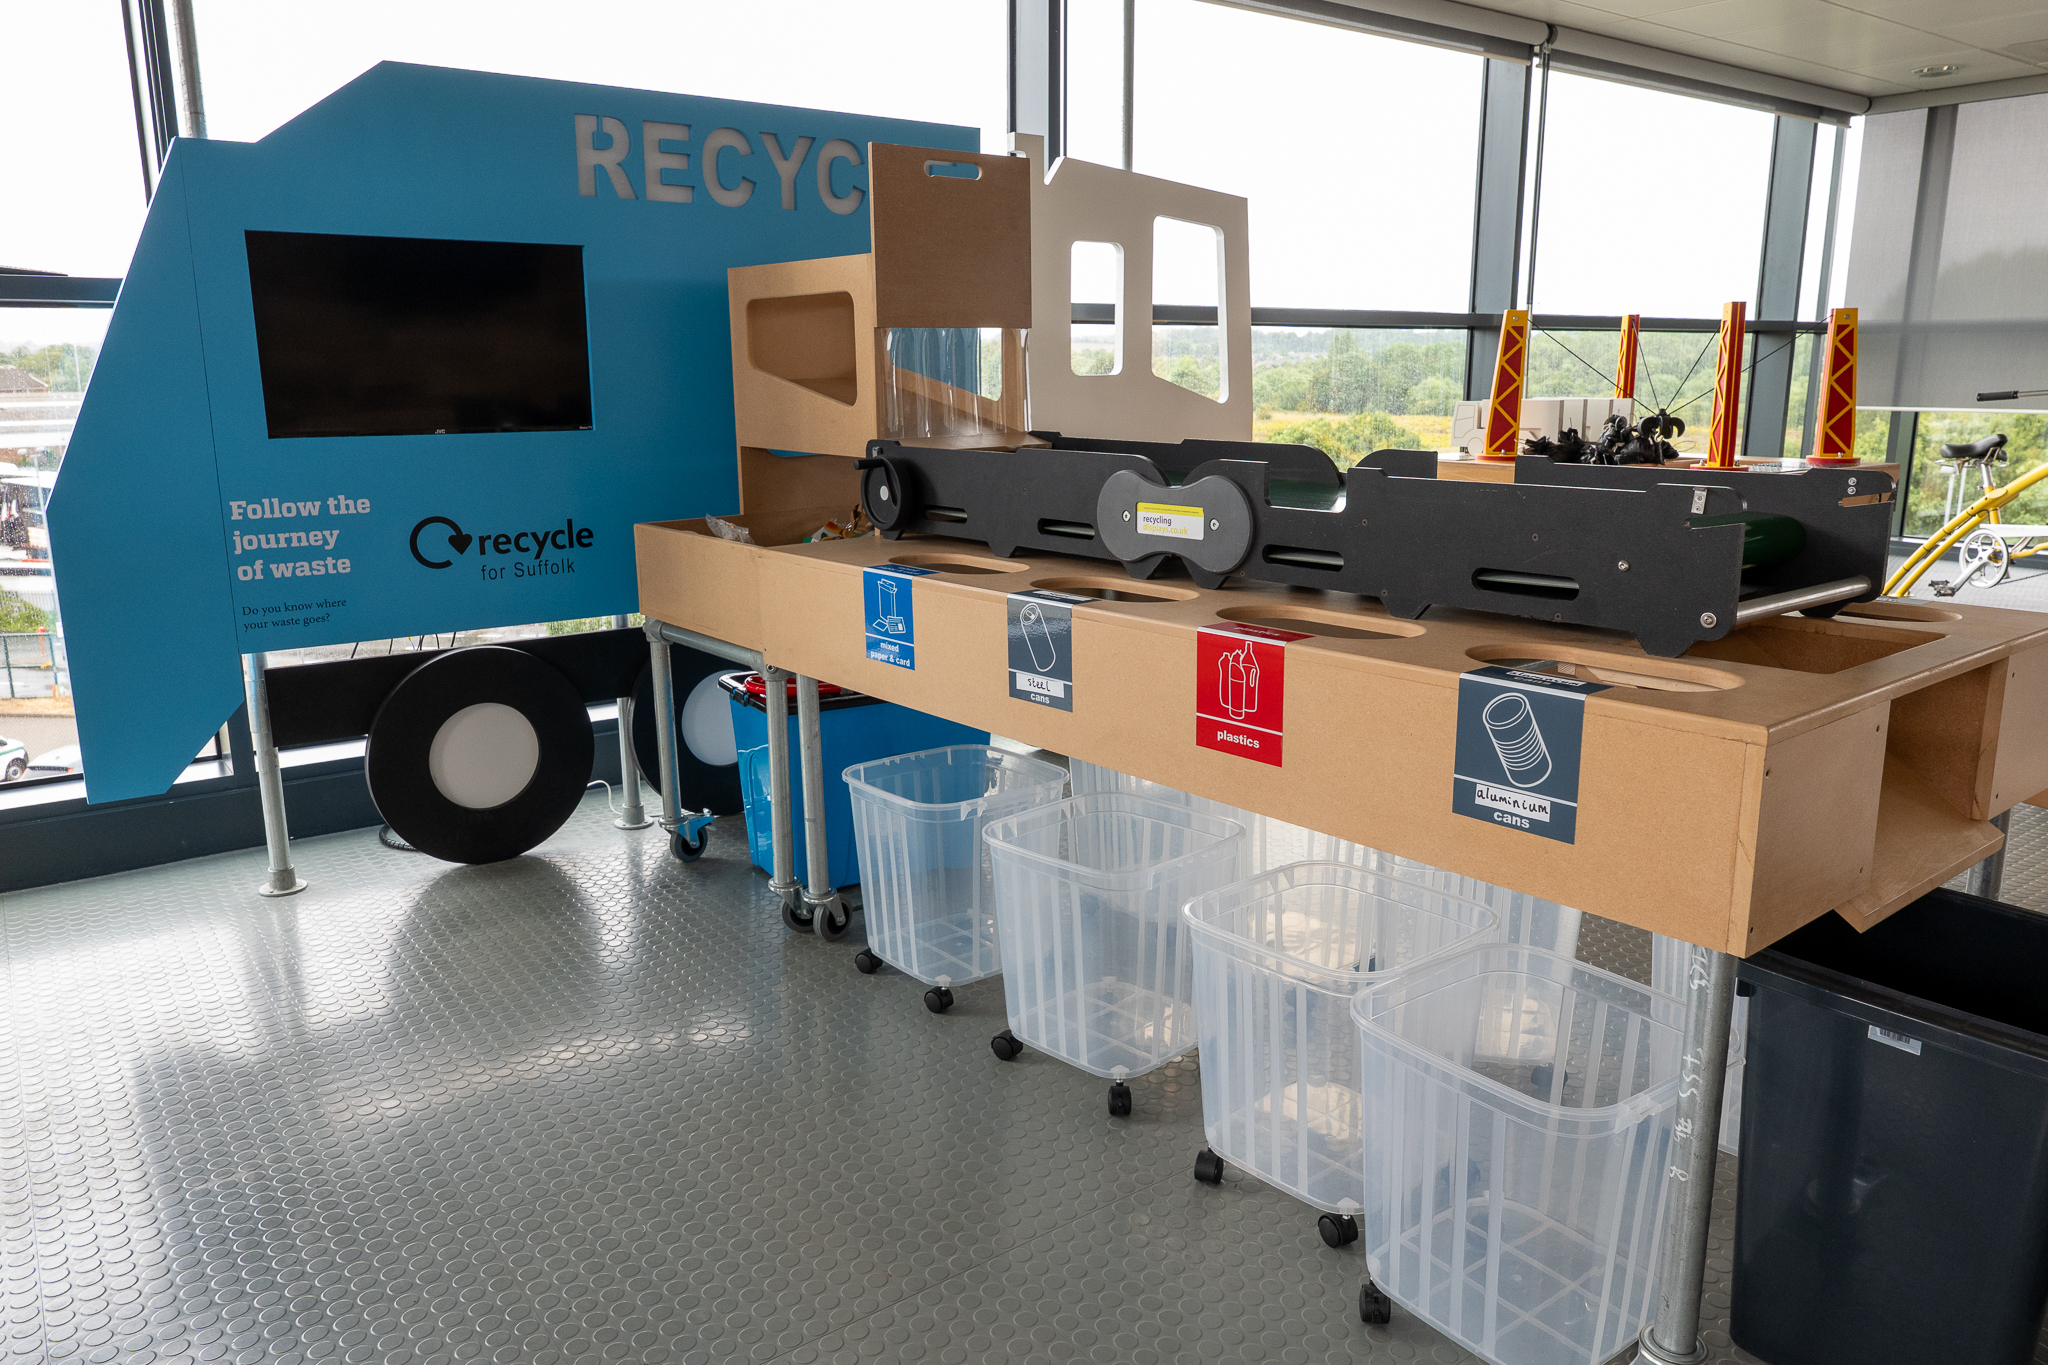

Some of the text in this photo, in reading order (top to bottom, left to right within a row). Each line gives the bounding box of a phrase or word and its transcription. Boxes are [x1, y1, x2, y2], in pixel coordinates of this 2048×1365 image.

[229, 495, 371, 520] Follow the
[1143, 516, 1172, 526] recycling
[1143, 523, 1188, 535] displays.co.uk
[233, 530, 340, 555] journey
[478, 518, 594, 560] recycle
[237, 557, 351, 581] of waste
[481, 558, 575, 581] for Suffolk
[242, 599, 347, 617] Do you know where
[243, 613, 330, 633] your waste goes?
[880, 642, 899, 652] mixed
[870, 651, 910, 667] paper & card
[1027, 678, 1051, 692] steel
[1030, 693, 1050, 704] cans
[1217, 730, 1260, 749] plastics
[1477, 788, 1548, 815] aluminium
[1493, 811, 1530, 829] cans
